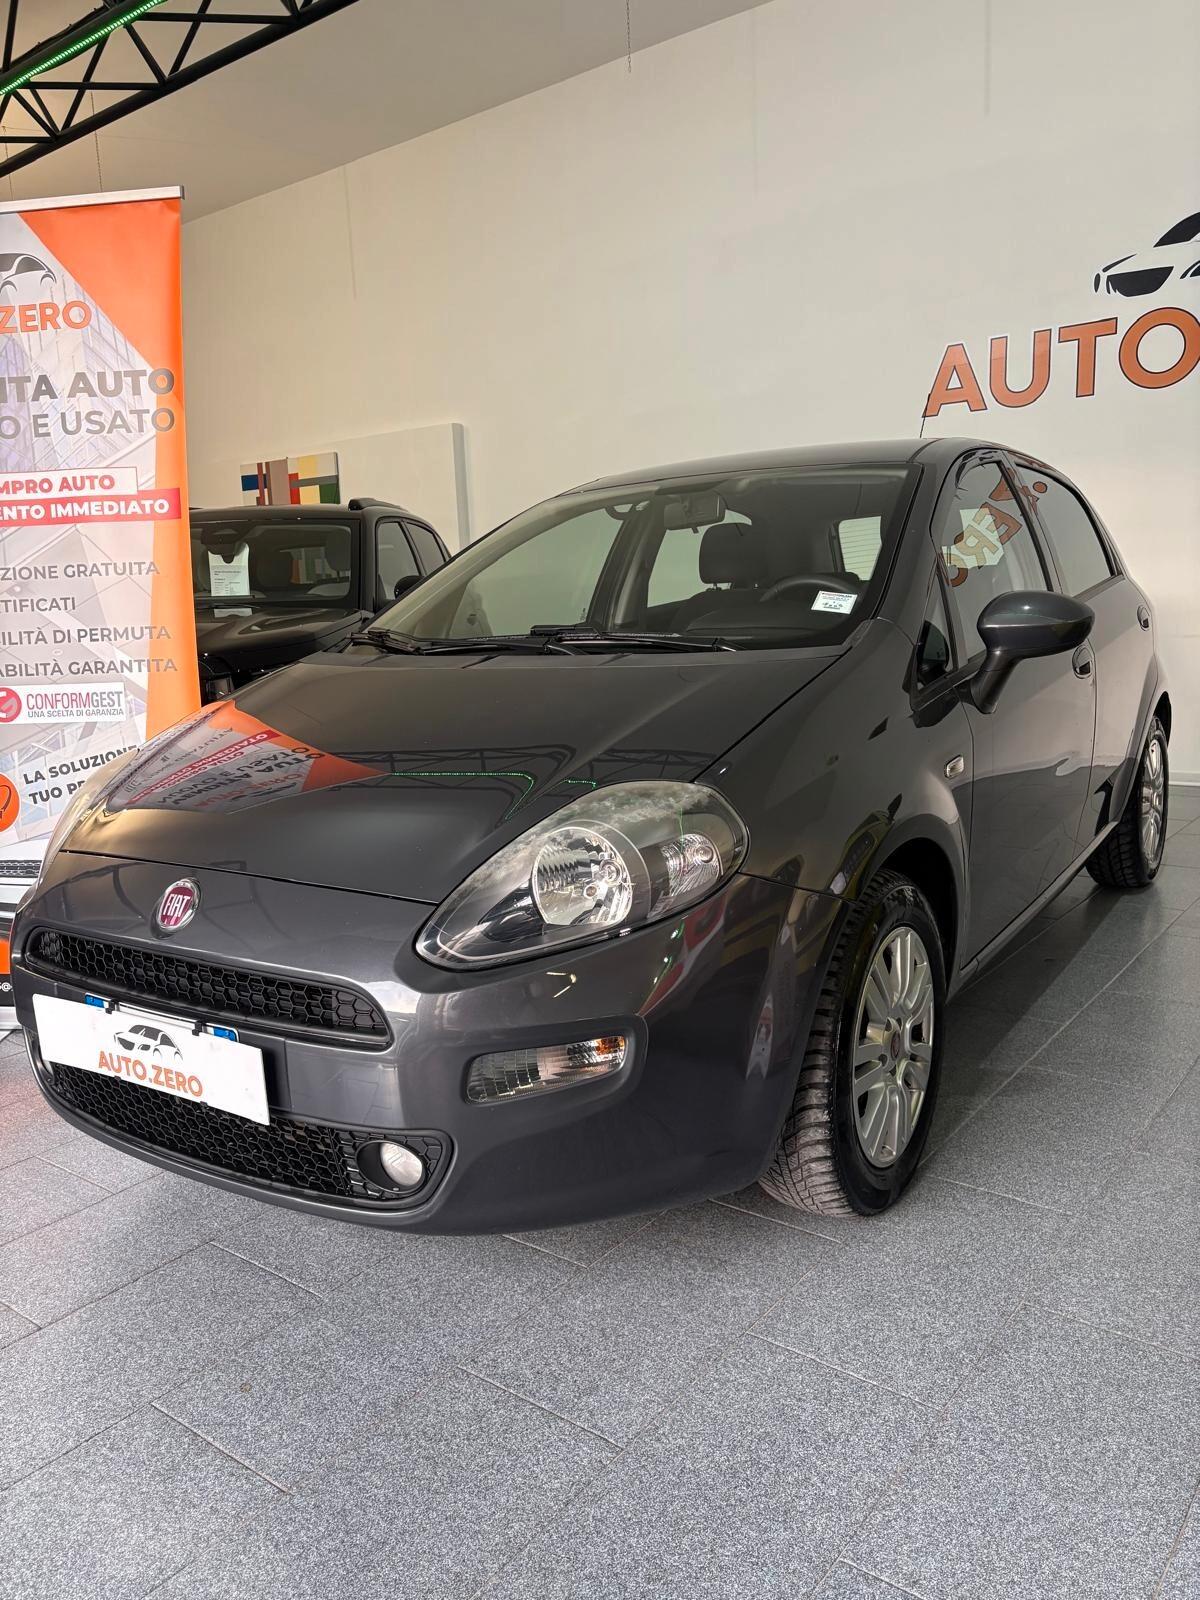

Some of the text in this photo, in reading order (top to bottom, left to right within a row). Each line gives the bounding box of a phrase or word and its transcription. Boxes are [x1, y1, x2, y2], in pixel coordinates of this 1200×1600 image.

[921, 306, 1200, 418] AUTO
[67, 368, 175, 399] AUTO
[32, 413, 51, 438] E
[60, 407, 175, 435] USATO
[58, 475, 115, 492] AUTO
[51, 499, 170, 518] IMMEDIATO
[63, 561, 160, 579] GRATUITA
[53, 629, 71, 644] DI
[77, 625, 171, 643] PERMUTA
[68, 657, 178, 675] GARANTITA
[26, 691, 123, 710] CONFORMGEST
[27, 708, 124, 718] UNA SCELTA DI GARANZIA
[23, 770, 46, 784] LA
[28, 787, 62, 805] TUO
[162, 893, 191, 918] FIAT
[98, 1050, 204, 1097] AUTO.ZERO
